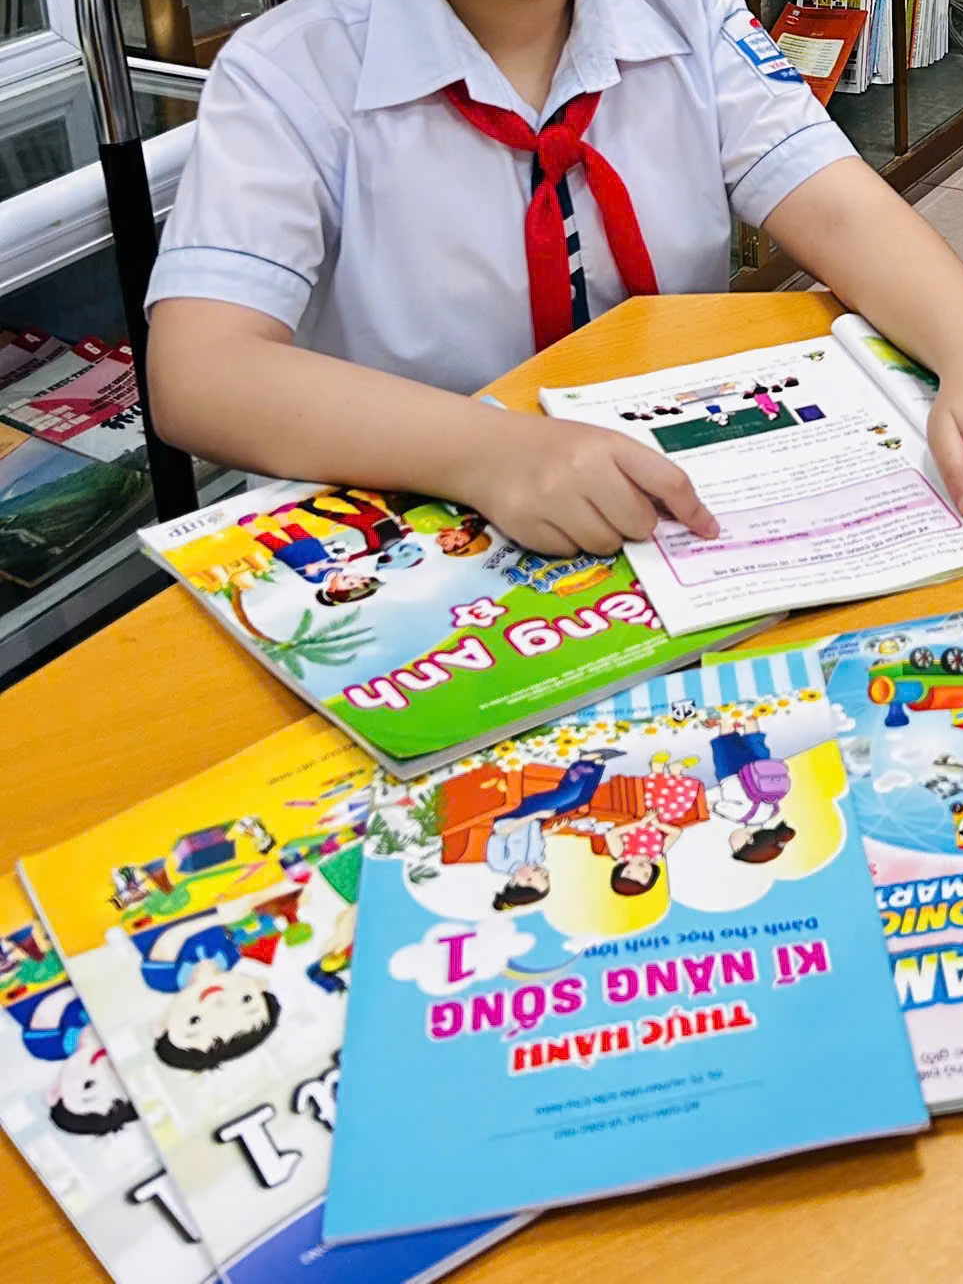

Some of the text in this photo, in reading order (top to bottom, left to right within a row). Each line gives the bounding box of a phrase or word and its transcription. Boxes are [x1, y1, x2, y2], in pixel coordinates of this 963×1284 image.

[343, 636, 495, 712] Anh
[438, 932, 477, 983] 1
[583, 916, 818, 960] Dành cho học sinh lớp
[430, 940, 829, 1040] KĨ NĂNG SỐNG
[512, 1004, 752, 1071] THỰC HÀNH
[212, 1103, 302, 1190] 1
